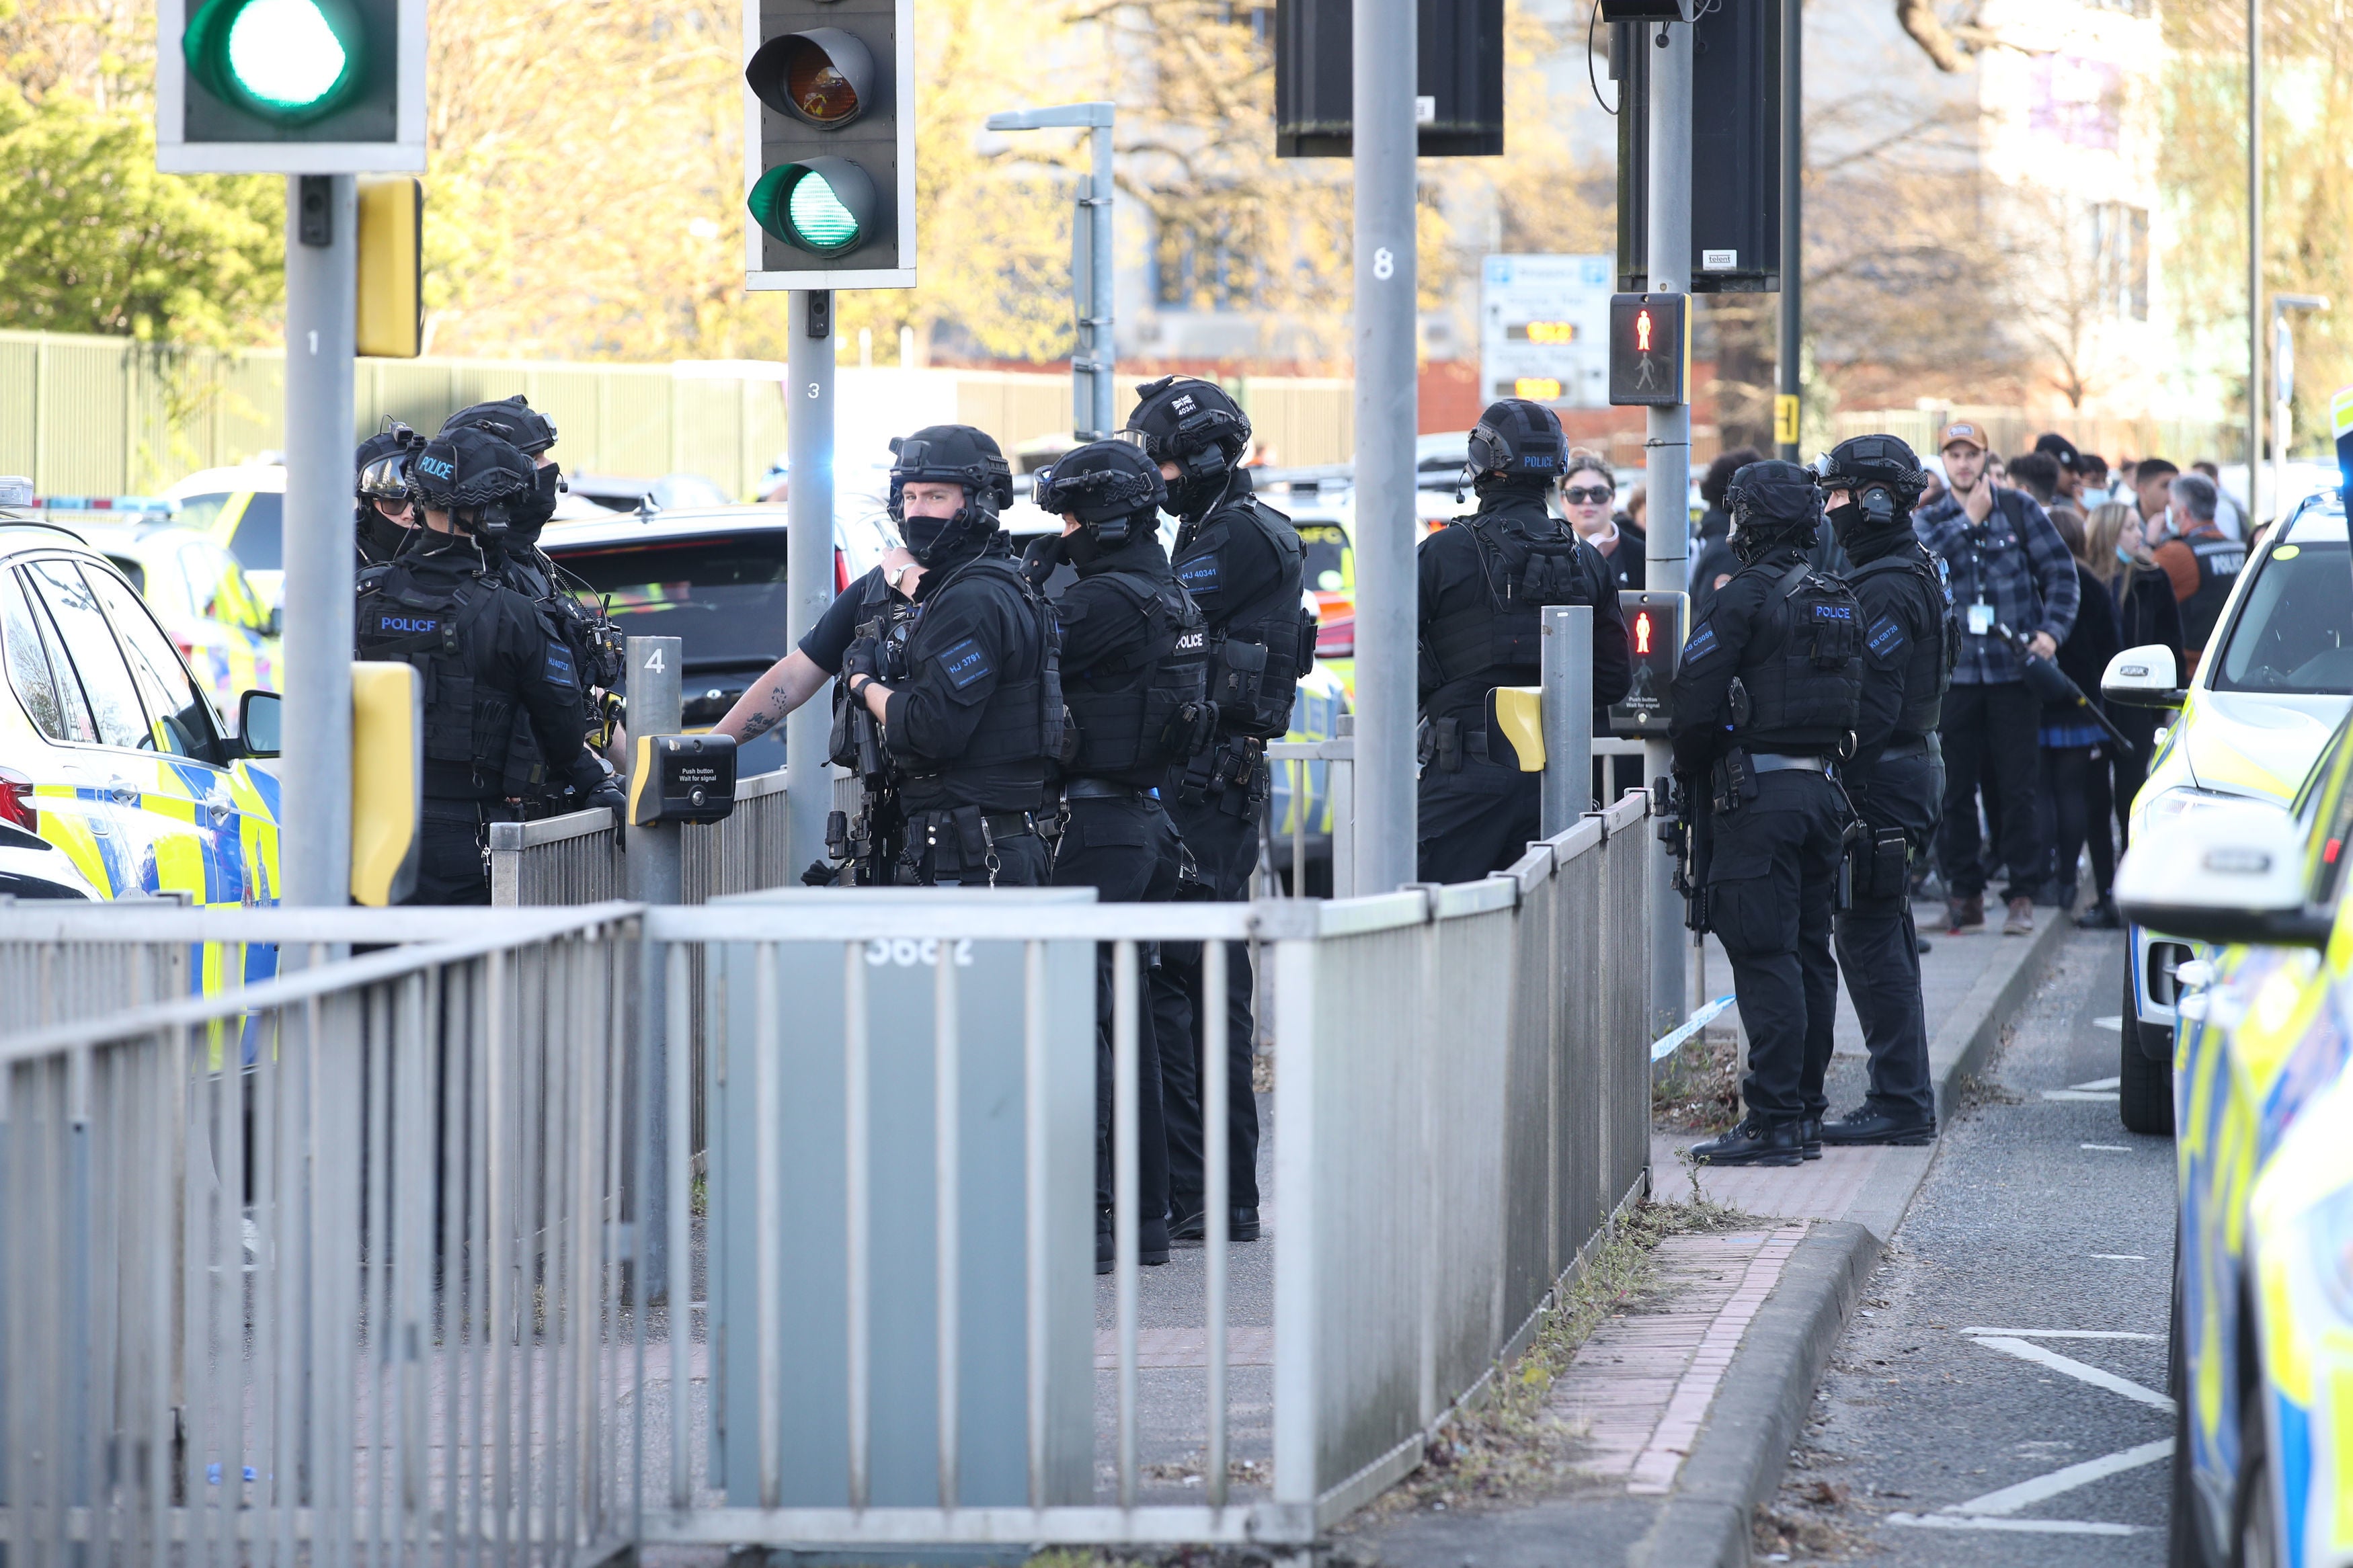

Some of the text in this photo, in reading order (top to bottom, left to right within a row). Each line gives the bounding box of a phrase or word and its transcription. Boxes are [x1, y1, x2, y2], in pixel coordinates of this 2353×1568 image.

[1373, 247, 1394, 280] 8
[1709, 255, 1730, 263] telent
[307, 329, 318, 355] 1
[808, 382, 820, 399] 3
[1179, 403, 1196, 415] 40341
[419, 456, 454, 480] POLICE
[1524, 456, 1554, 467] POLICE
[1182, 569, 1216, 579] HJ 40341
[1817, 606, 1850, 618] POLICE
[381, 617, 436, 632] POLICE
[1684, 643, 1693, 653] KB
[1693, 630, 1713, 646] CG059
[1869, 639, 1880, 649] KB
[1879, 624, 1899, 642] CB720
[643, 648, 665, 673] 4
[949, 652, 980, 673] HJ 3791
